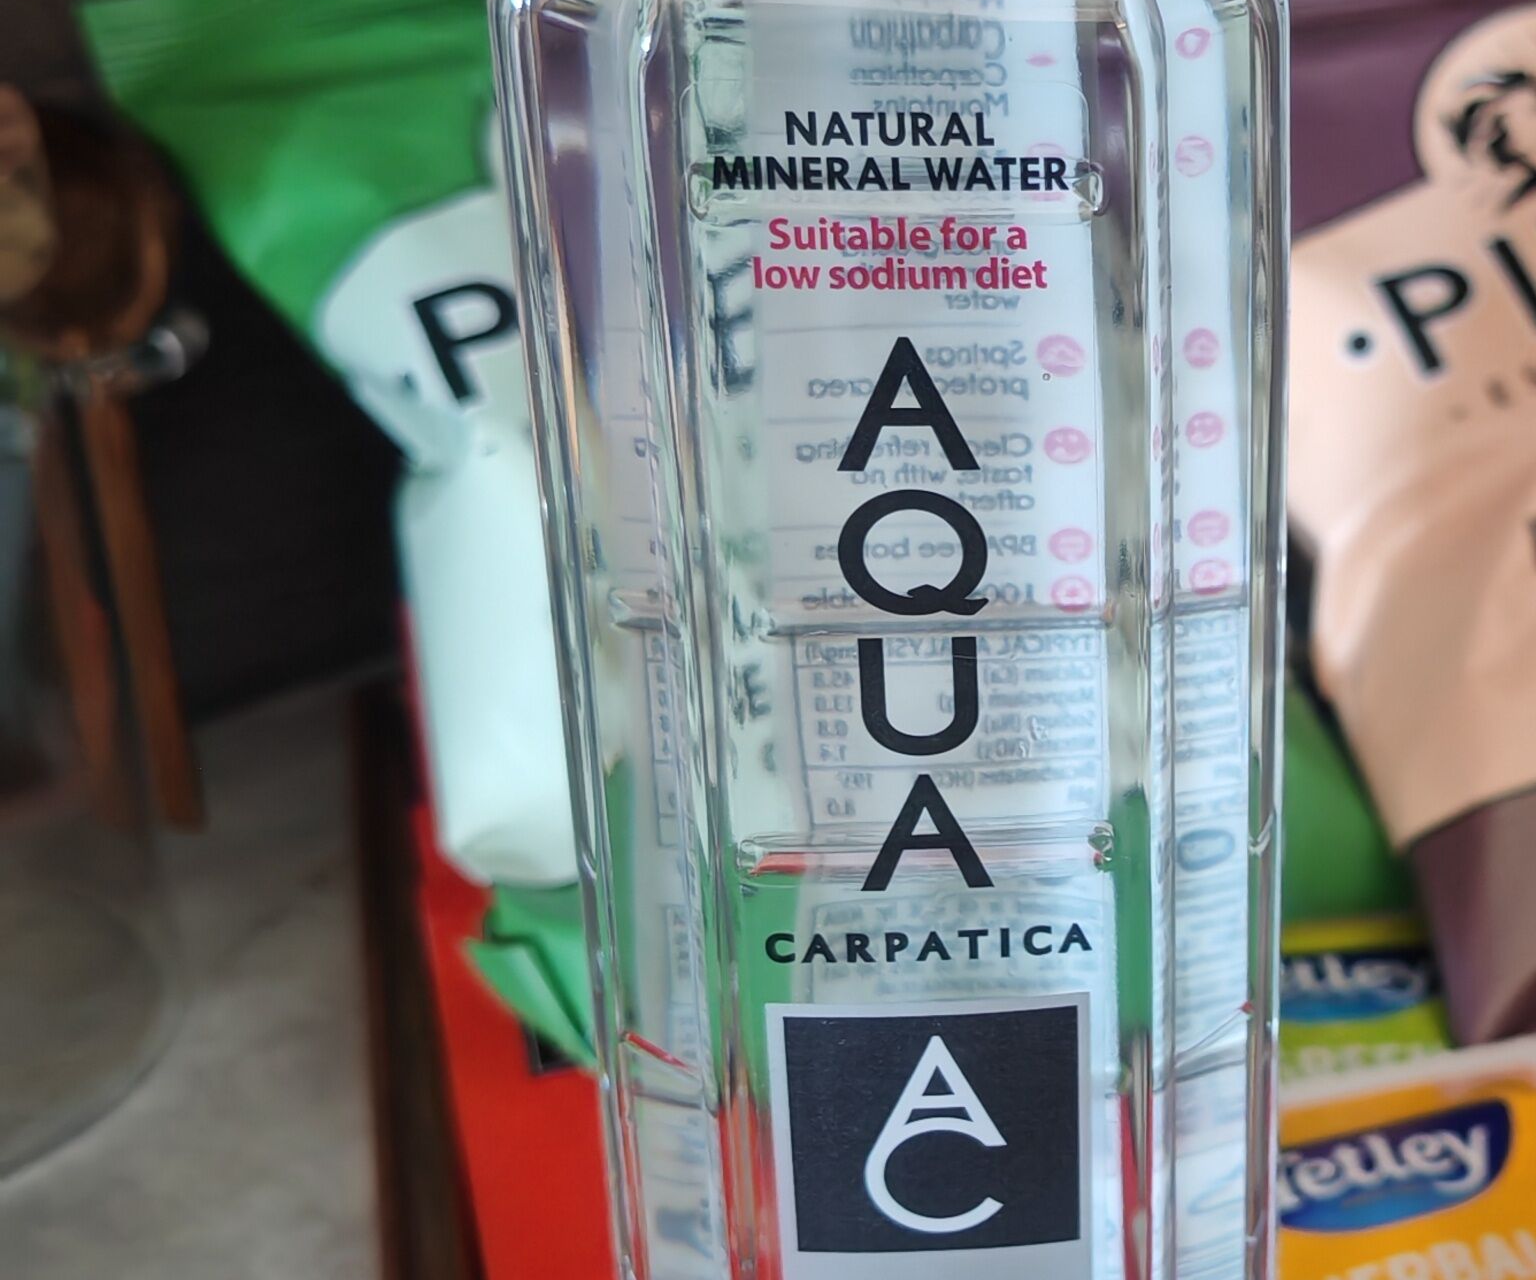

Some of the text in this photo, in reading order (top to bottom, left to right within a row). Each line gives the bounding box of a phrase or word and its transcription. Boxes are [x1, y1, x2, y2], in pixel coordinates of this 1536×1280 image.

[783, 111, 995, 147] NATURAL
[711, 156, 1069, 193] MINERAL WATER
[768, 217, 932, 251] Suitable
[940, 217, 997, 251] for
[1006, 224, 1028, 251] a
[752, 256, 1048, 290] low sodium diet
[837, 336, 994, 891] AQUA
[764, 922, 1094, 965] CARPATICA
